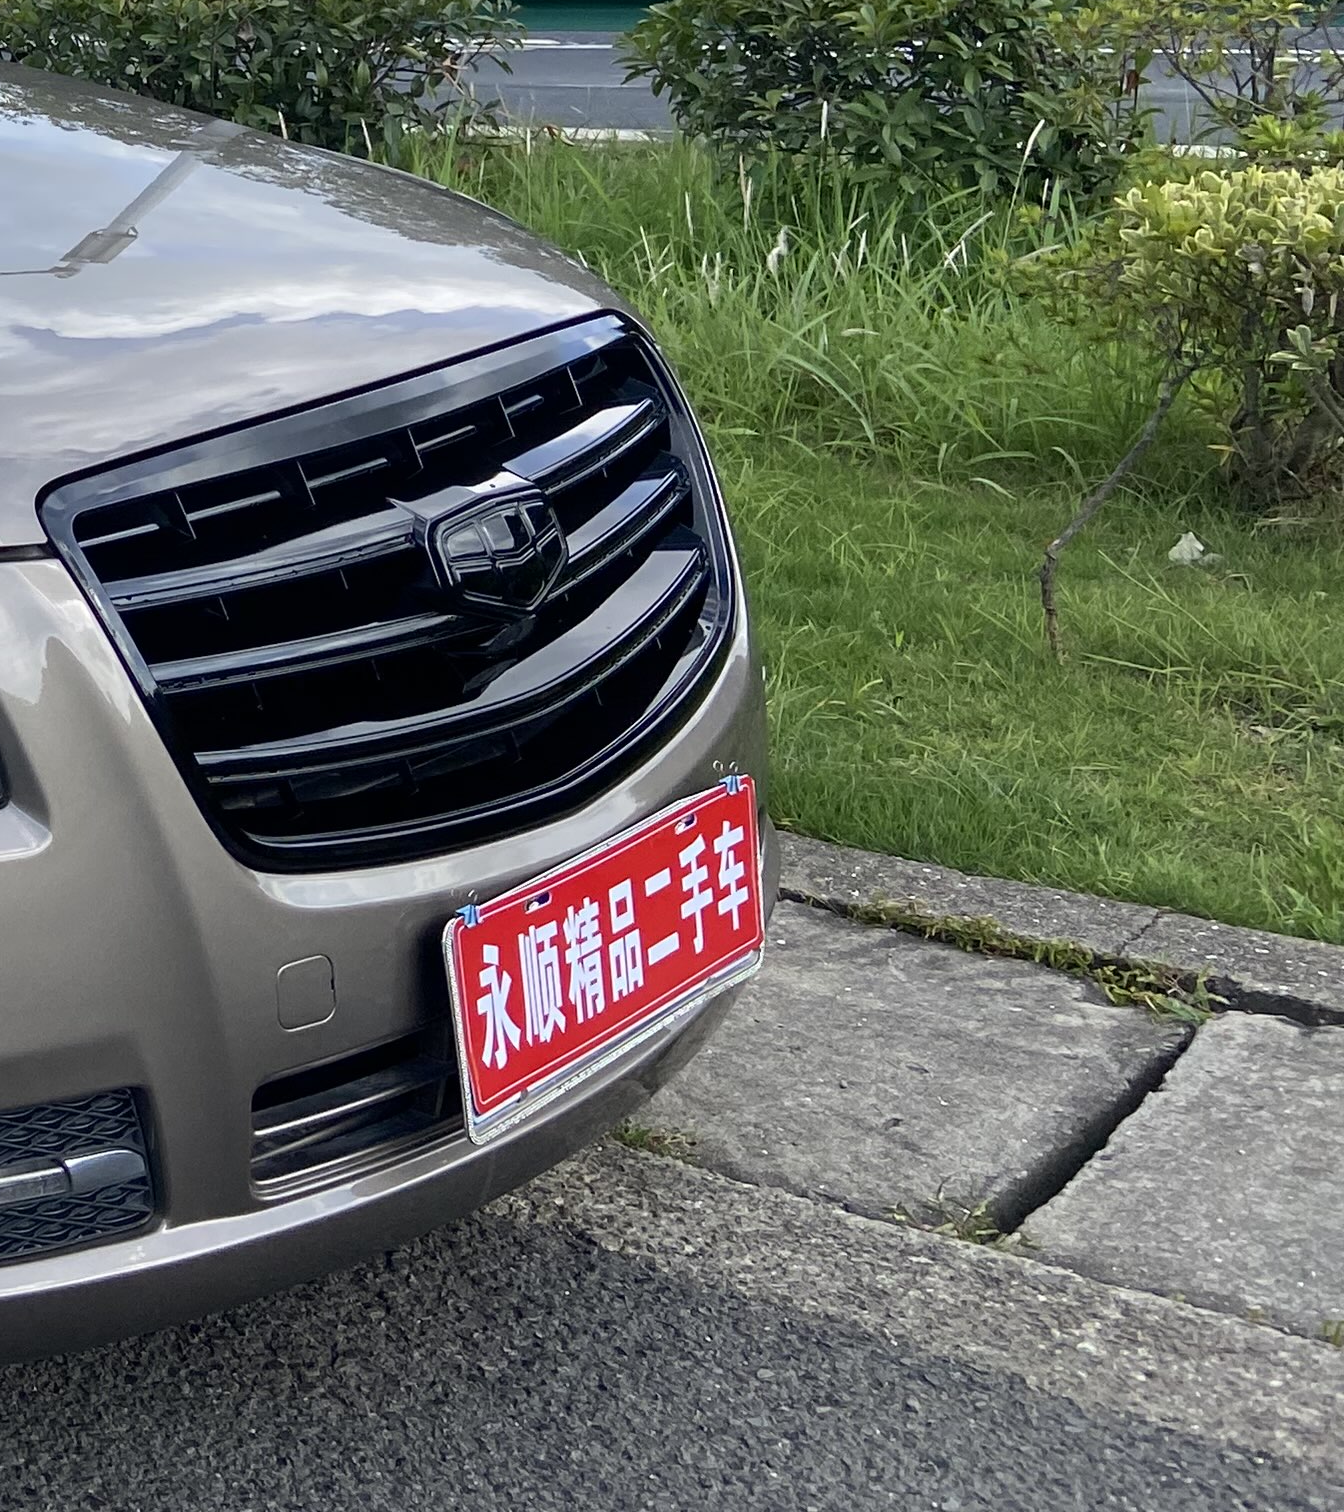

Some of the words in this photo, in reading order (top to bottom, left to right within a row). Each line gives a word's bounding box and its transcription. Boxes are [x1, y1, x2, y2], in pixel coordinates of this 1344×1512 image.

[477, 820, 749, 1070] 永顺精品二手车
